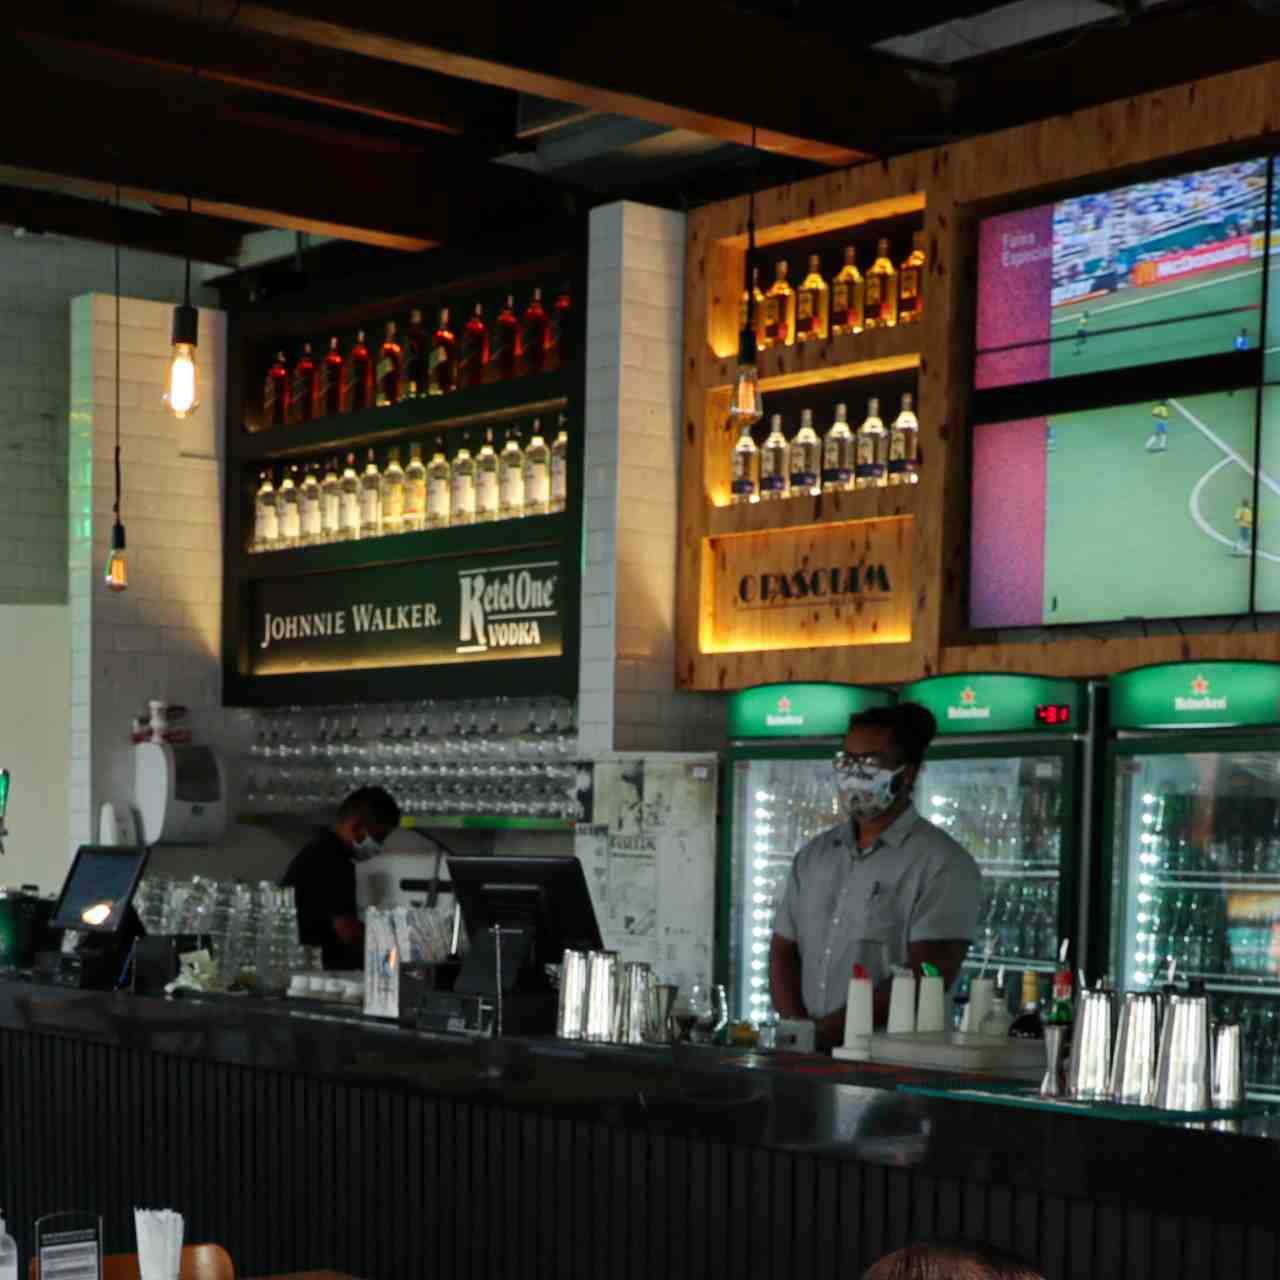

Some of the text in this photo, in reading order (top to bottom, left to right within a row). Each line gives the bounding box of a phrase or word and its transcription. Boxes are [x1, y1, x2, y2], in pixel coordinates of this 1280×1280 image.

[458, 570, 555, 648] Ketel One
[261, 612, 346, 648] JOHNNIE
[487, 621, 541, 647] VODKA
